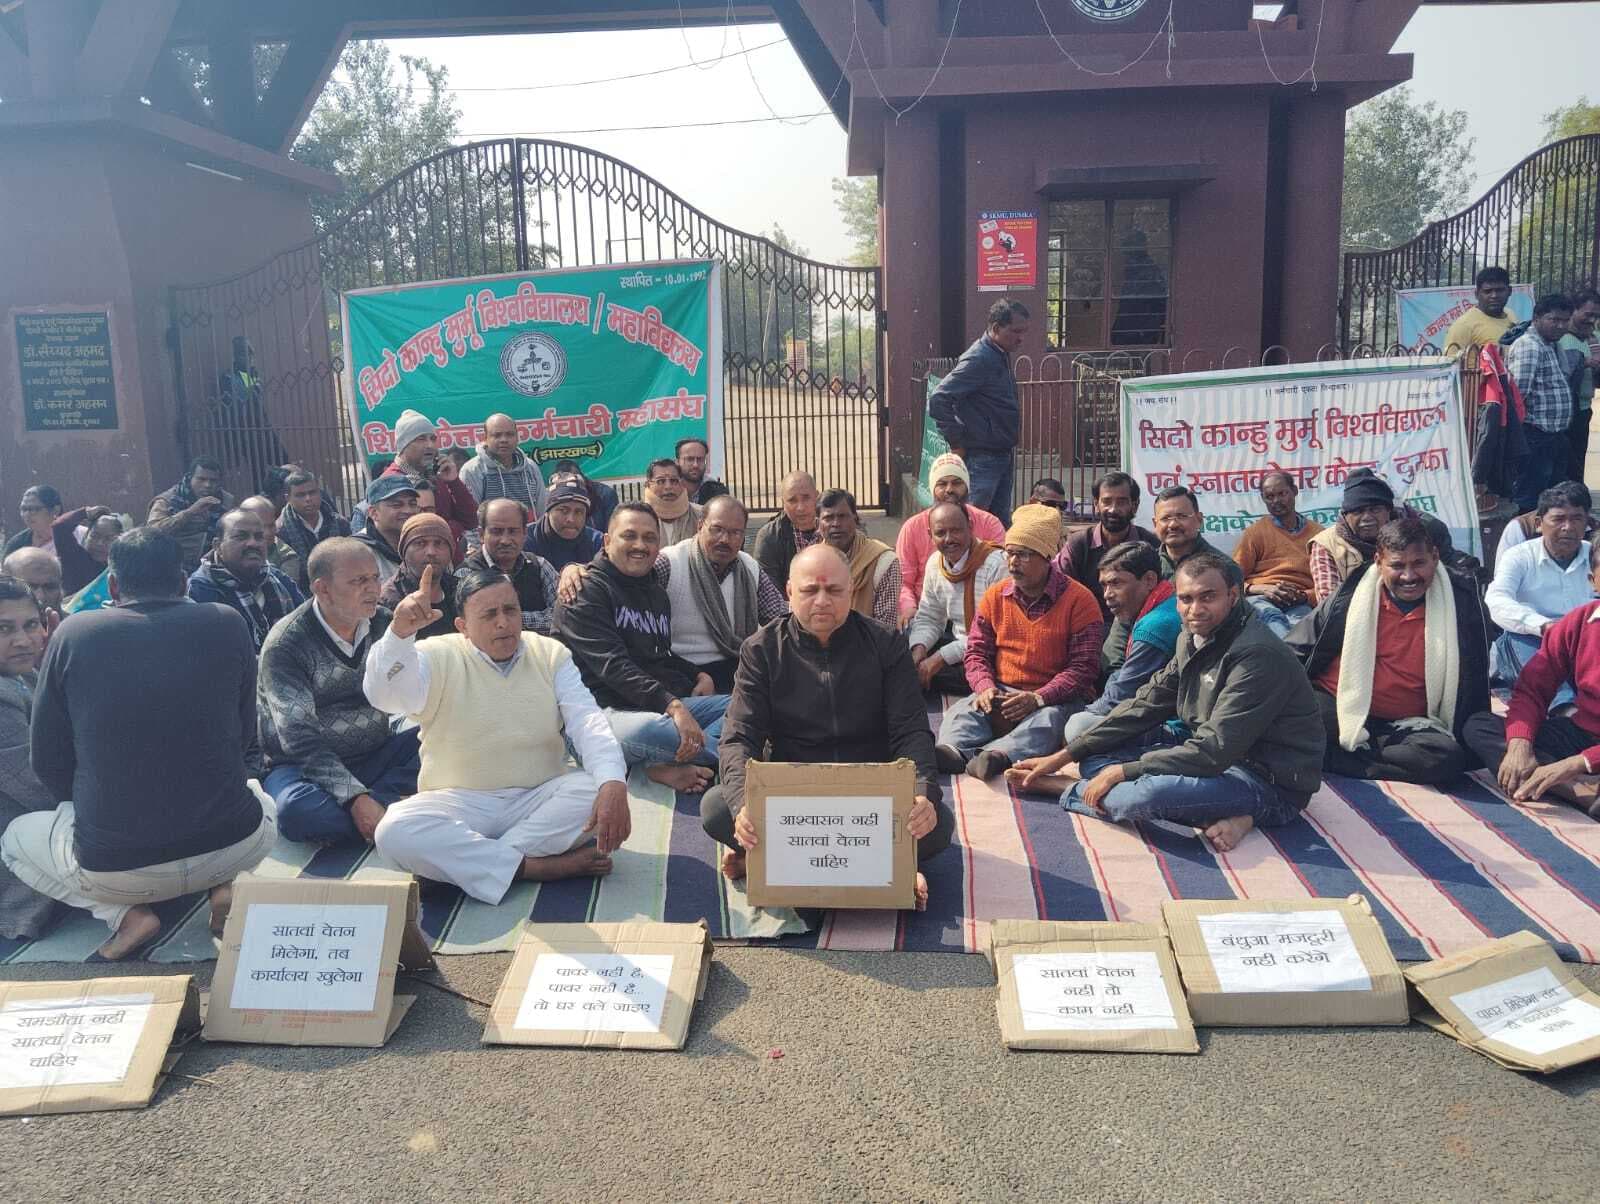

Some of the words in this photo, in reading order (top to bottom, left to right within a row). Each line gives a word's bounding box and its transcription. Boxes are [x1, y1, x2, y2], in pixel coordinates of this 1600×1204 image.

[619, 271, 653, 288] स्थापित
[359, 348, 400, 412] सिदो
[477, 281, 591, 332] विश्वविद्यालय
[1139, 419, 1193, 448] सिदो
[1200, 420, 1269, 454] कान्हु
[1275, 408, 1323, 451] मुर्मू
[1325, 401, 1447, 439] विश्वविद्याल
[534, 441, 603, 464] (झारखण्ड)
[1146, 464, 1182, 496] एवं
[778, 814, 844, 826] आश्वासन
[836, 833, 871, 847] वेतन
[808, 854, 849, 868] चाहिए
[272, 923, 314, 937] सातवां
[321, 923, 357, 937] वेतन
[1218, 934, 1269, 949] बंधुआ
[328, 948, 352, 960] तब
[250, 967, 309, 982] कार्यालय
[316, 968, 364, 986] खुलेगा
[1096, 965, 1136, 978] वेतन
[548, 983, 583, 993] पावर
[1104, 983, 1122, 996] तो
[533, 999, 551, 1010] तो
[555, 1001, 577, 1010] घर
[613, 1002, 651, 1013] जाइए
[1058, 1005, 1094, 1015] काम
[17, 1012, 86, 1028] समझौता
[72, 1031, 114, 1045] वेतन
[30, 1052, 80, 1068] चाहिए
